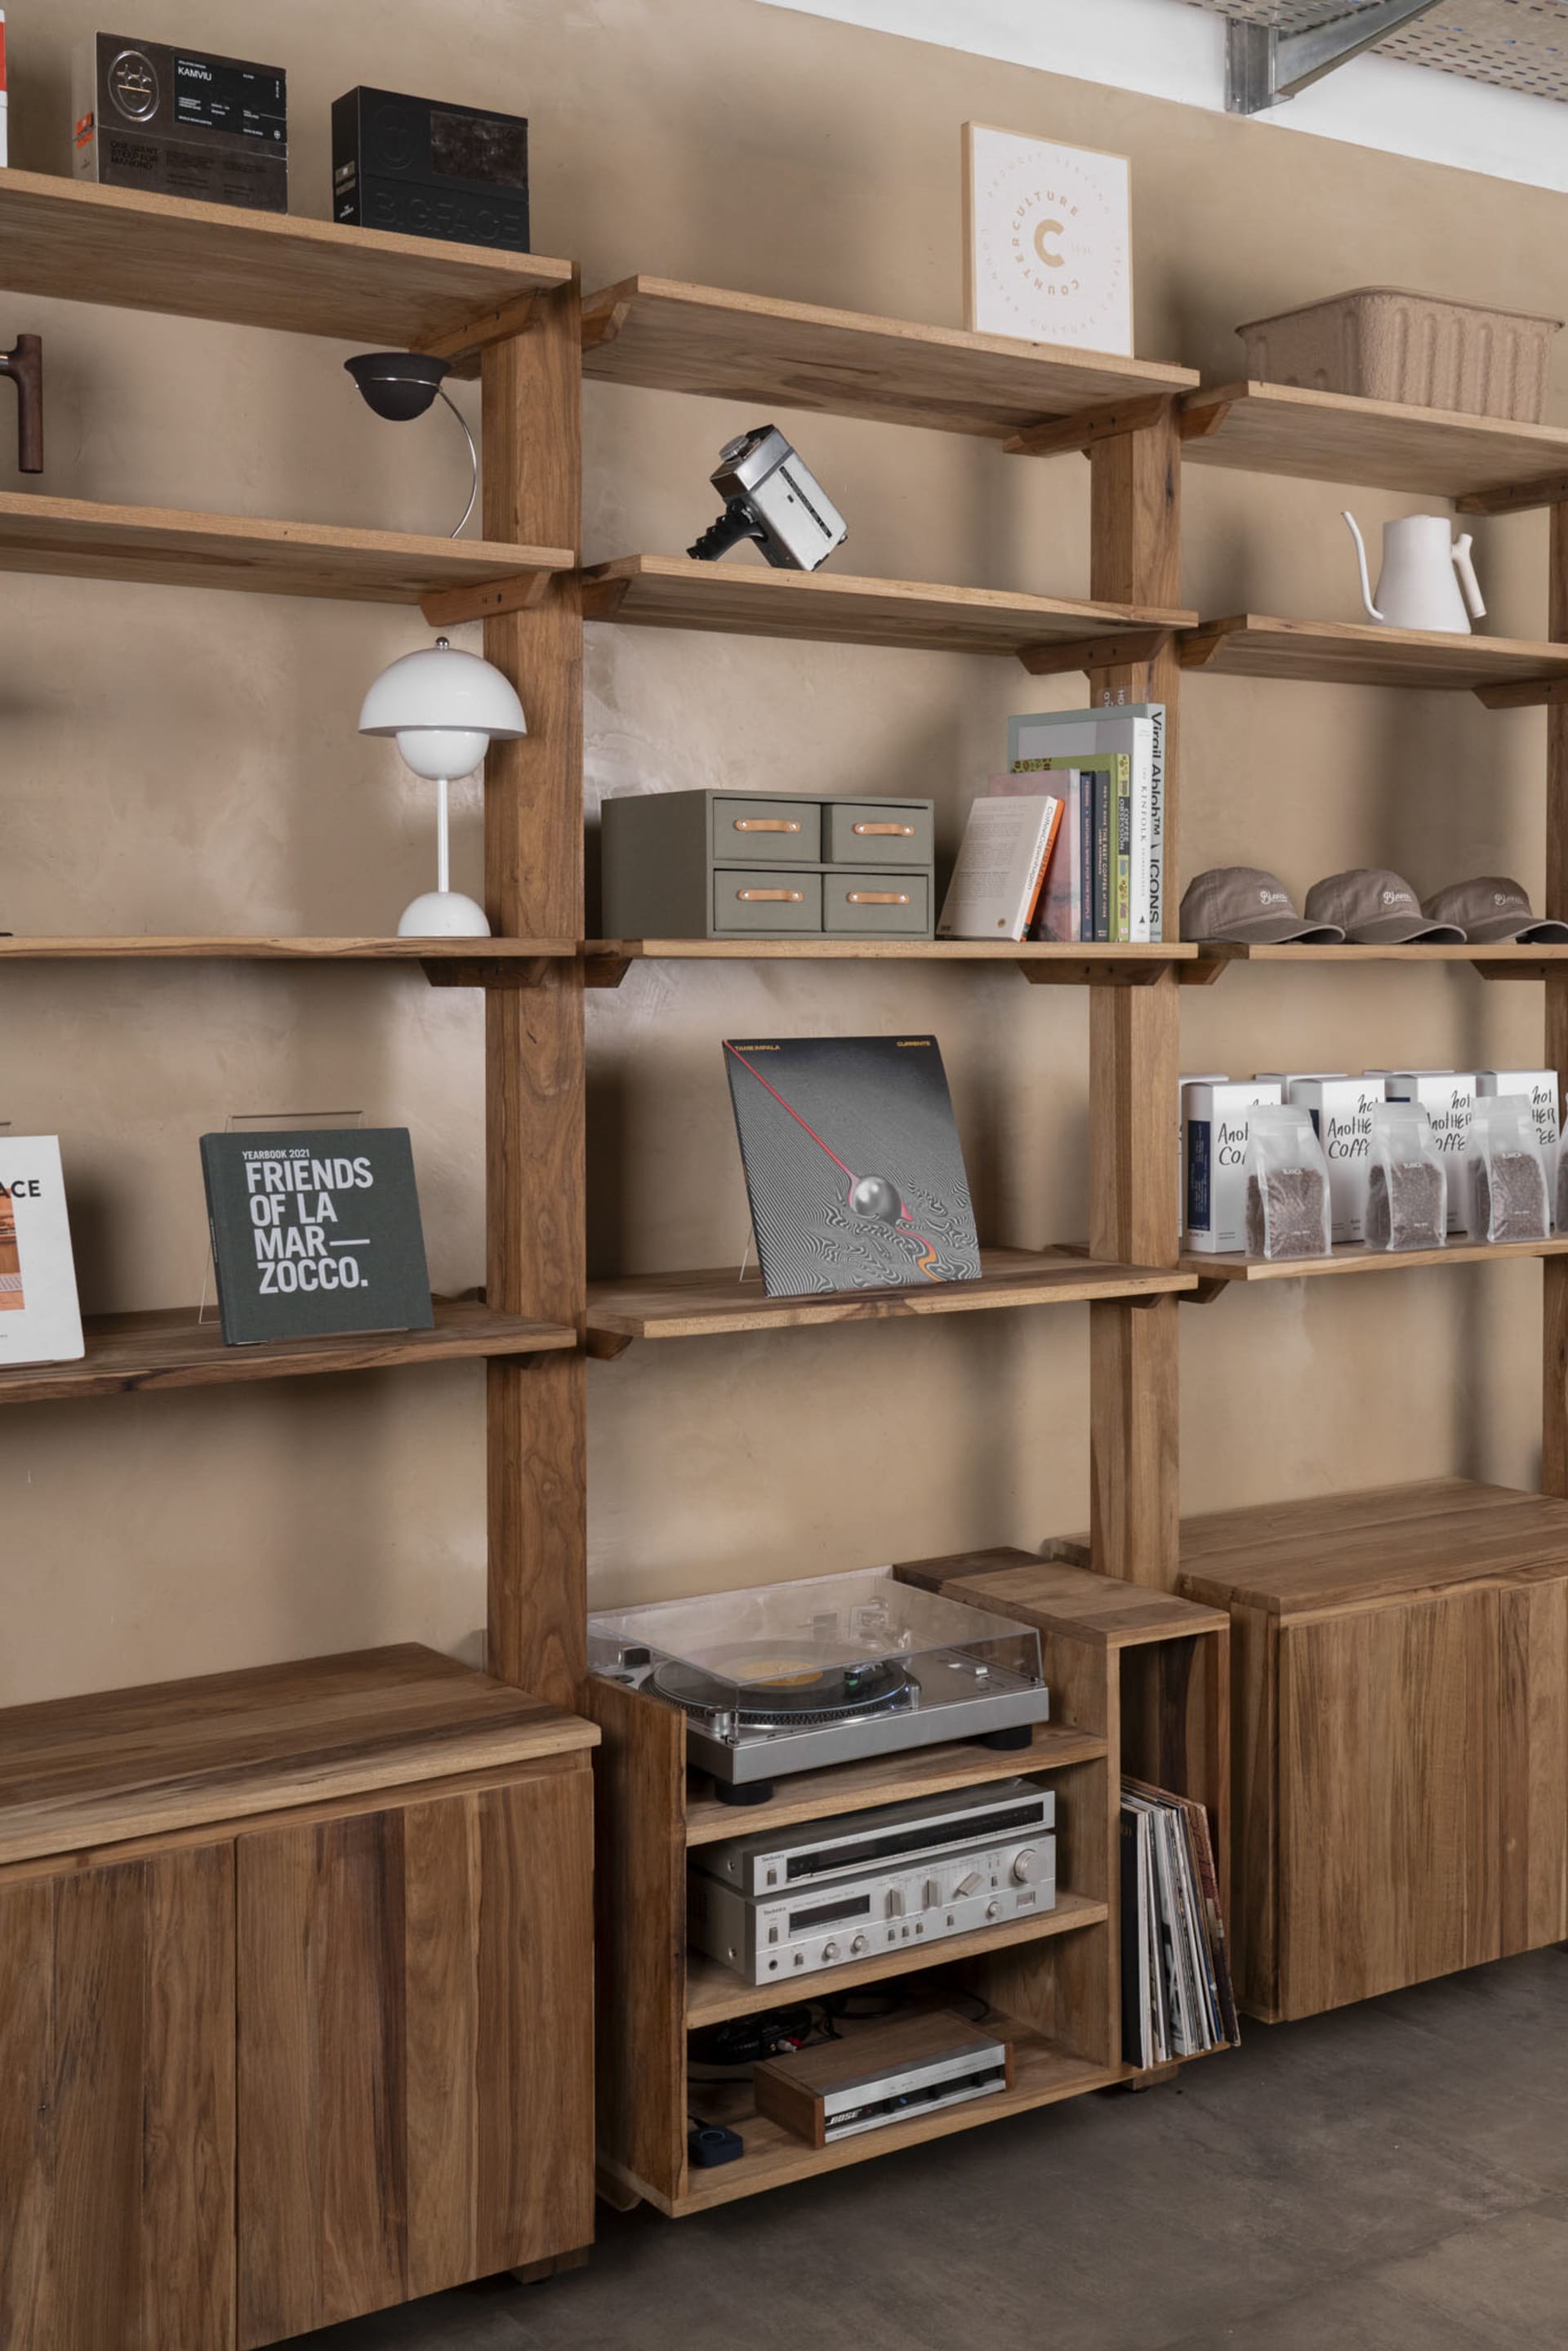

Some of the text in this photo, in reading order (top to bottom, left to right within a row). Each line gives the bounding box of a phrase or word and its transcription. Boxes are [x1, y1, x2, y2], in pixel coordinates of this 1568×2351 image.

[177, 65, 212, 82] KAMVIU
[1033, 218, 1065, 268] C
[242, 1148, 310, 1160] YEARBOOK 2021
[245, 1156, 374, 1193] FRIENDS
[249, 1191, 339, 1227] OF LA
[256, 1256, 369, 1294] ZOCCO.
[826, 2108, 862, 2126] BOSE
